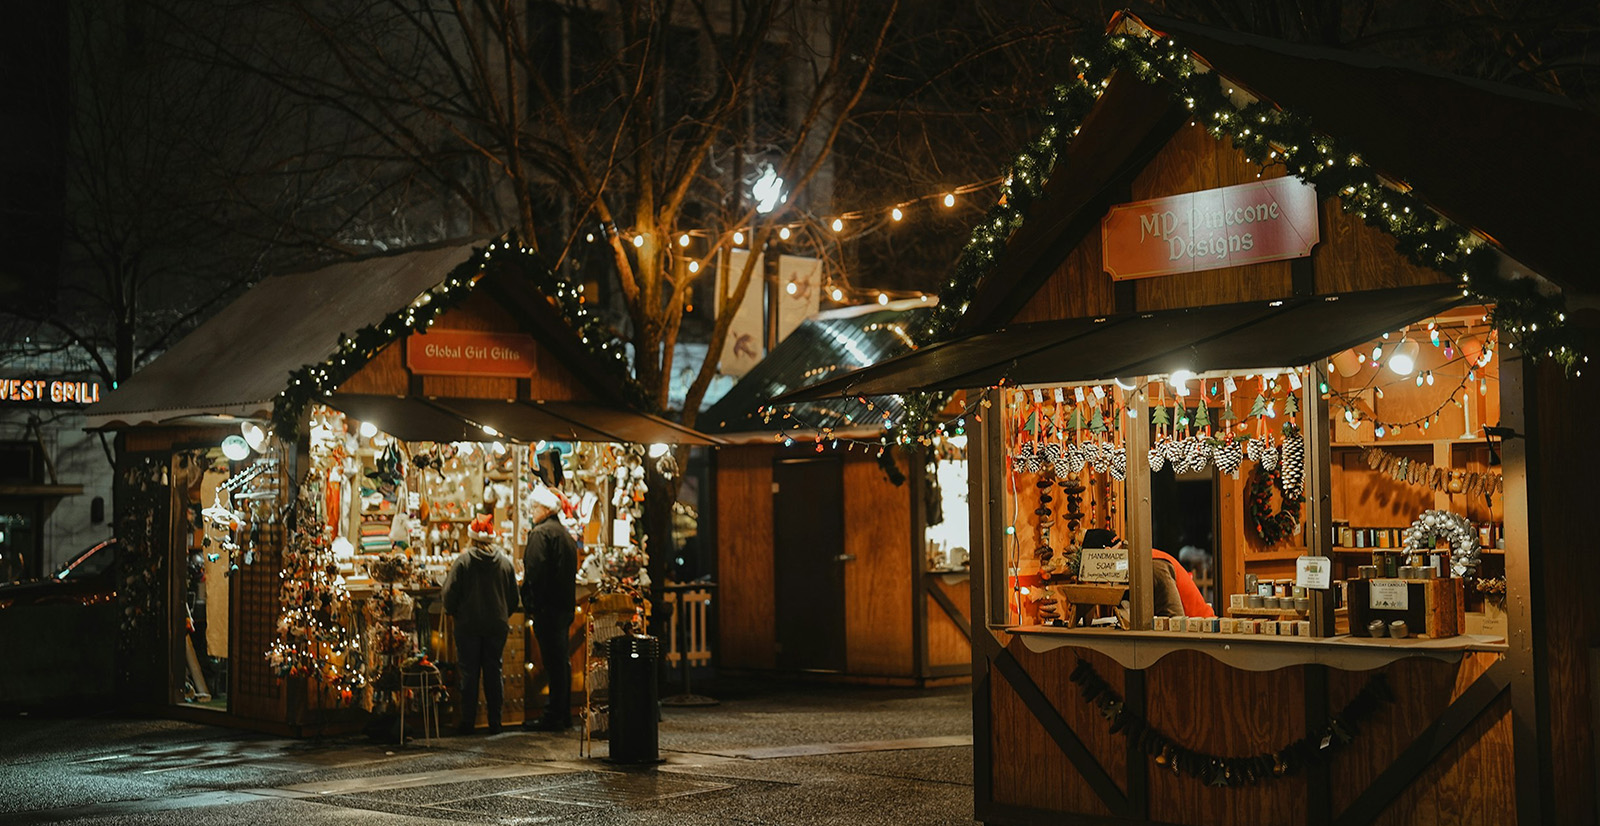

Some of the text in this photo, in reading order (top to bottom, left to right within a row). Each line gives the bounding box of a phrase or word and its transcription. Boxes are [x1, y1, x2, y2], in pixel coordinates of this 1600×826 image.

[1187, 200, 1281, 238] Pinecone
[1168, 232, 1254, 261] Designs
[425, 343, 520, 360] Global Girl Gifts
[1088, 552, 1124, 560] HANDMADE
[1096, 561, 1115, 570] SOAP
